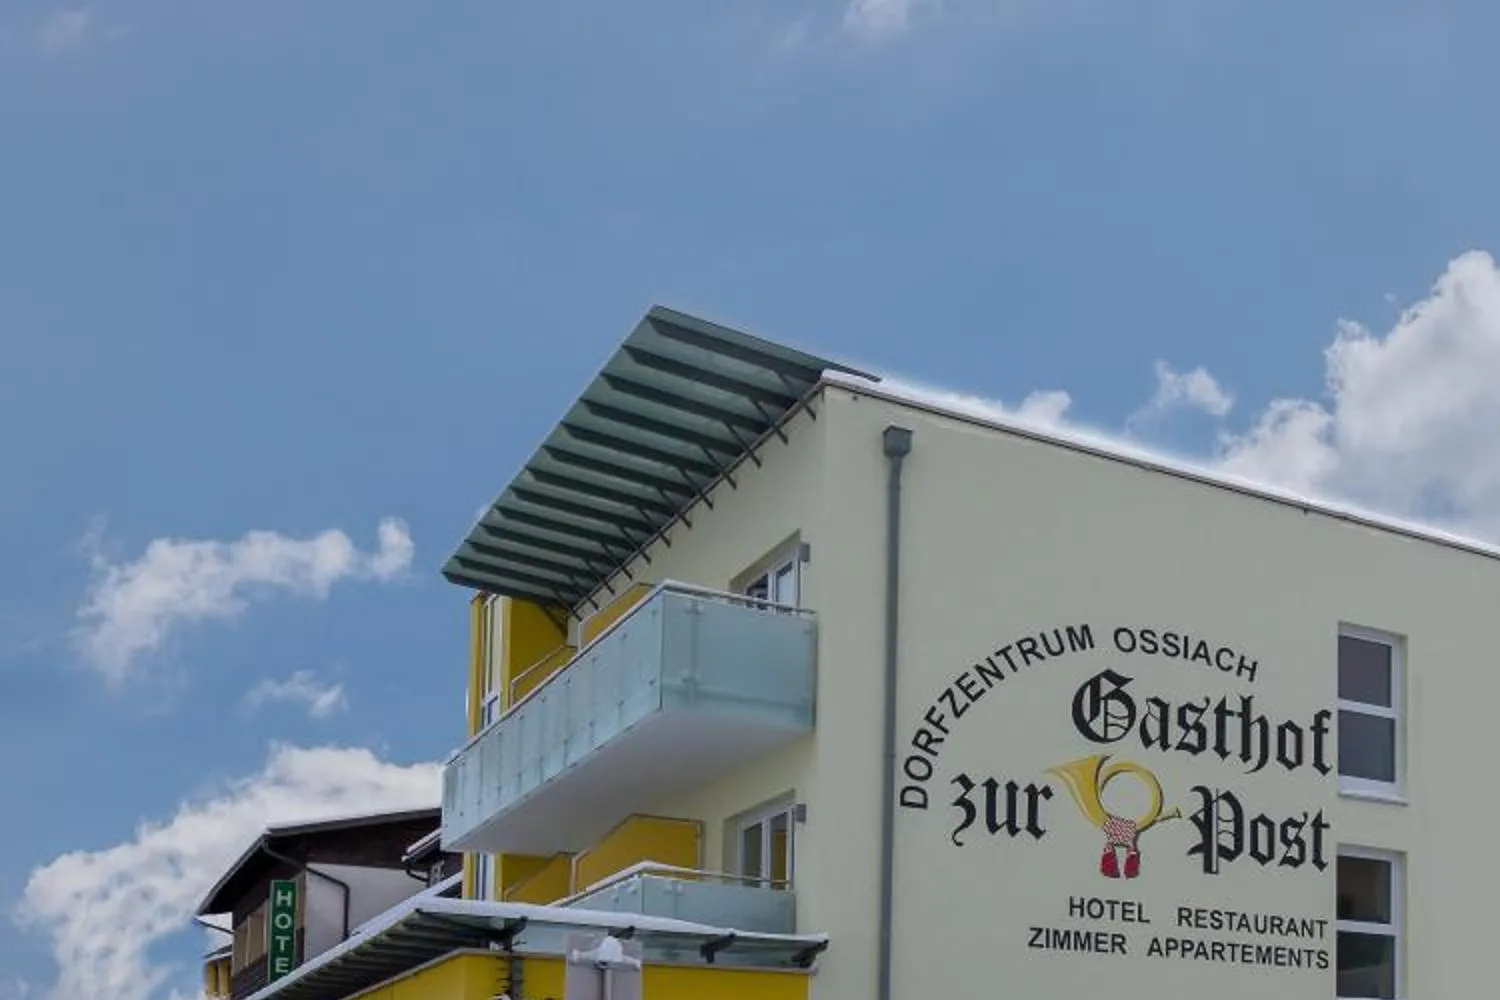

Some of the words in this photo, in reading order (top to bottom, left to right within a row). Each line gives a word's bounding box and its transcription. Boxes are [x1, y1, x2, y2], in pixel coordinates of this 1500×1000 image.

[900, 624, 1096, 811] DORFZENTRUM
[1113, 626, 1259, 683] OSSIACH
[1071, 669, 1333, 776] Gasthof
[950, 772, 1055, 847] zur
[1187, 785, 1331, 875] Post
[274, 890, 293, 974] HOTE
[1027, 927, 1127, 956] ZIMMER
[1146, 936, 1330, 970] APPARTEMENTS
[1068, 896, 1151, 924] HOTEL
[1177, 907, 1329, 940] RESTAURANT
